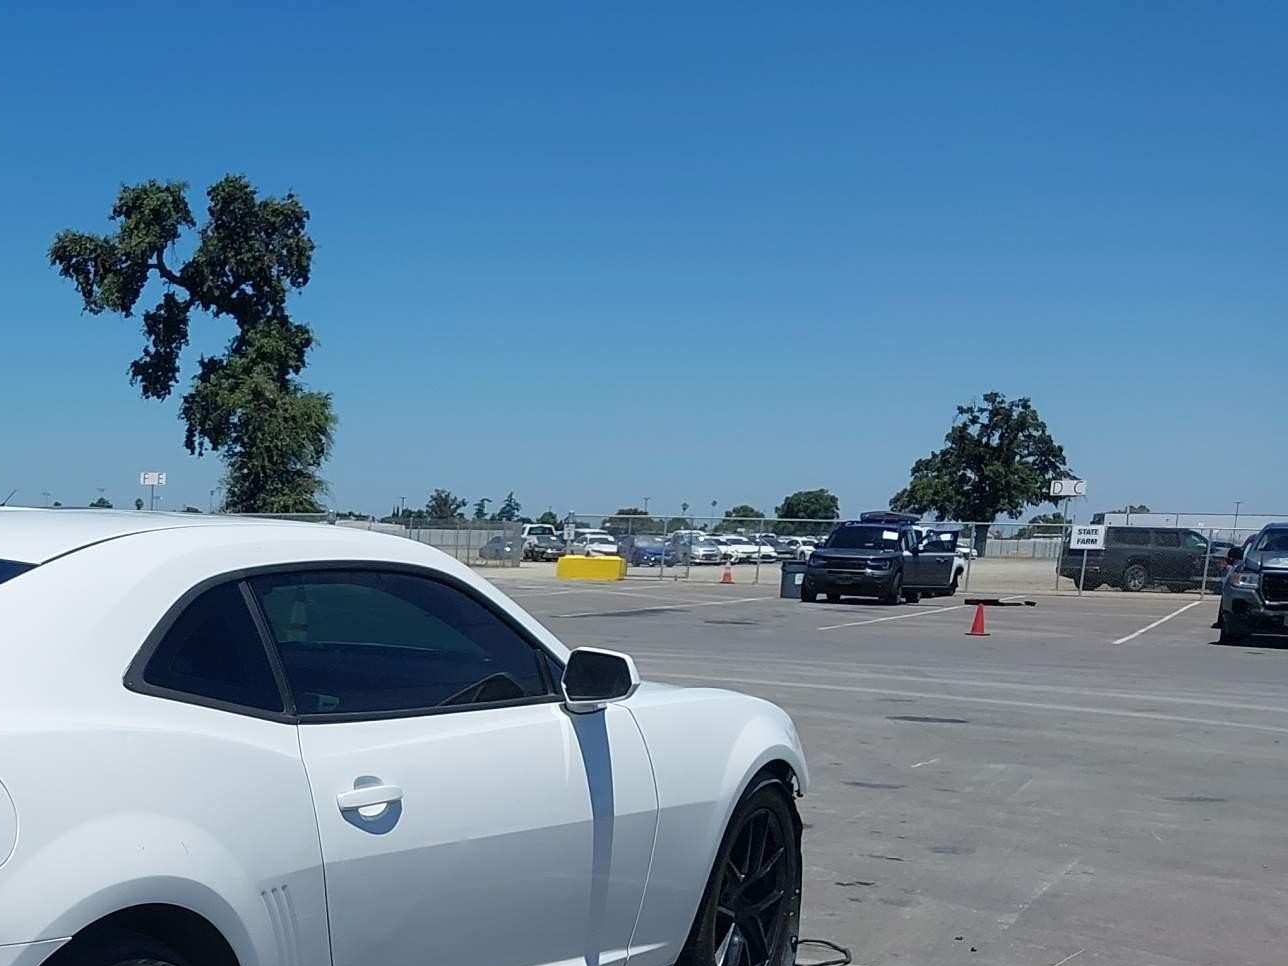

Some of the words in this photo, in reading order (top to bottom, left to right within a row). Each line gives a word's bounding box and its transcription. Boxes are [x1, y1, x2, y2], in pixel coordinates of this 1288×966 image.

[1053, 481, 1063, 495] D
[1073, 480, 1084, 495] C
[1077, 528, 1099, 536] STATE
